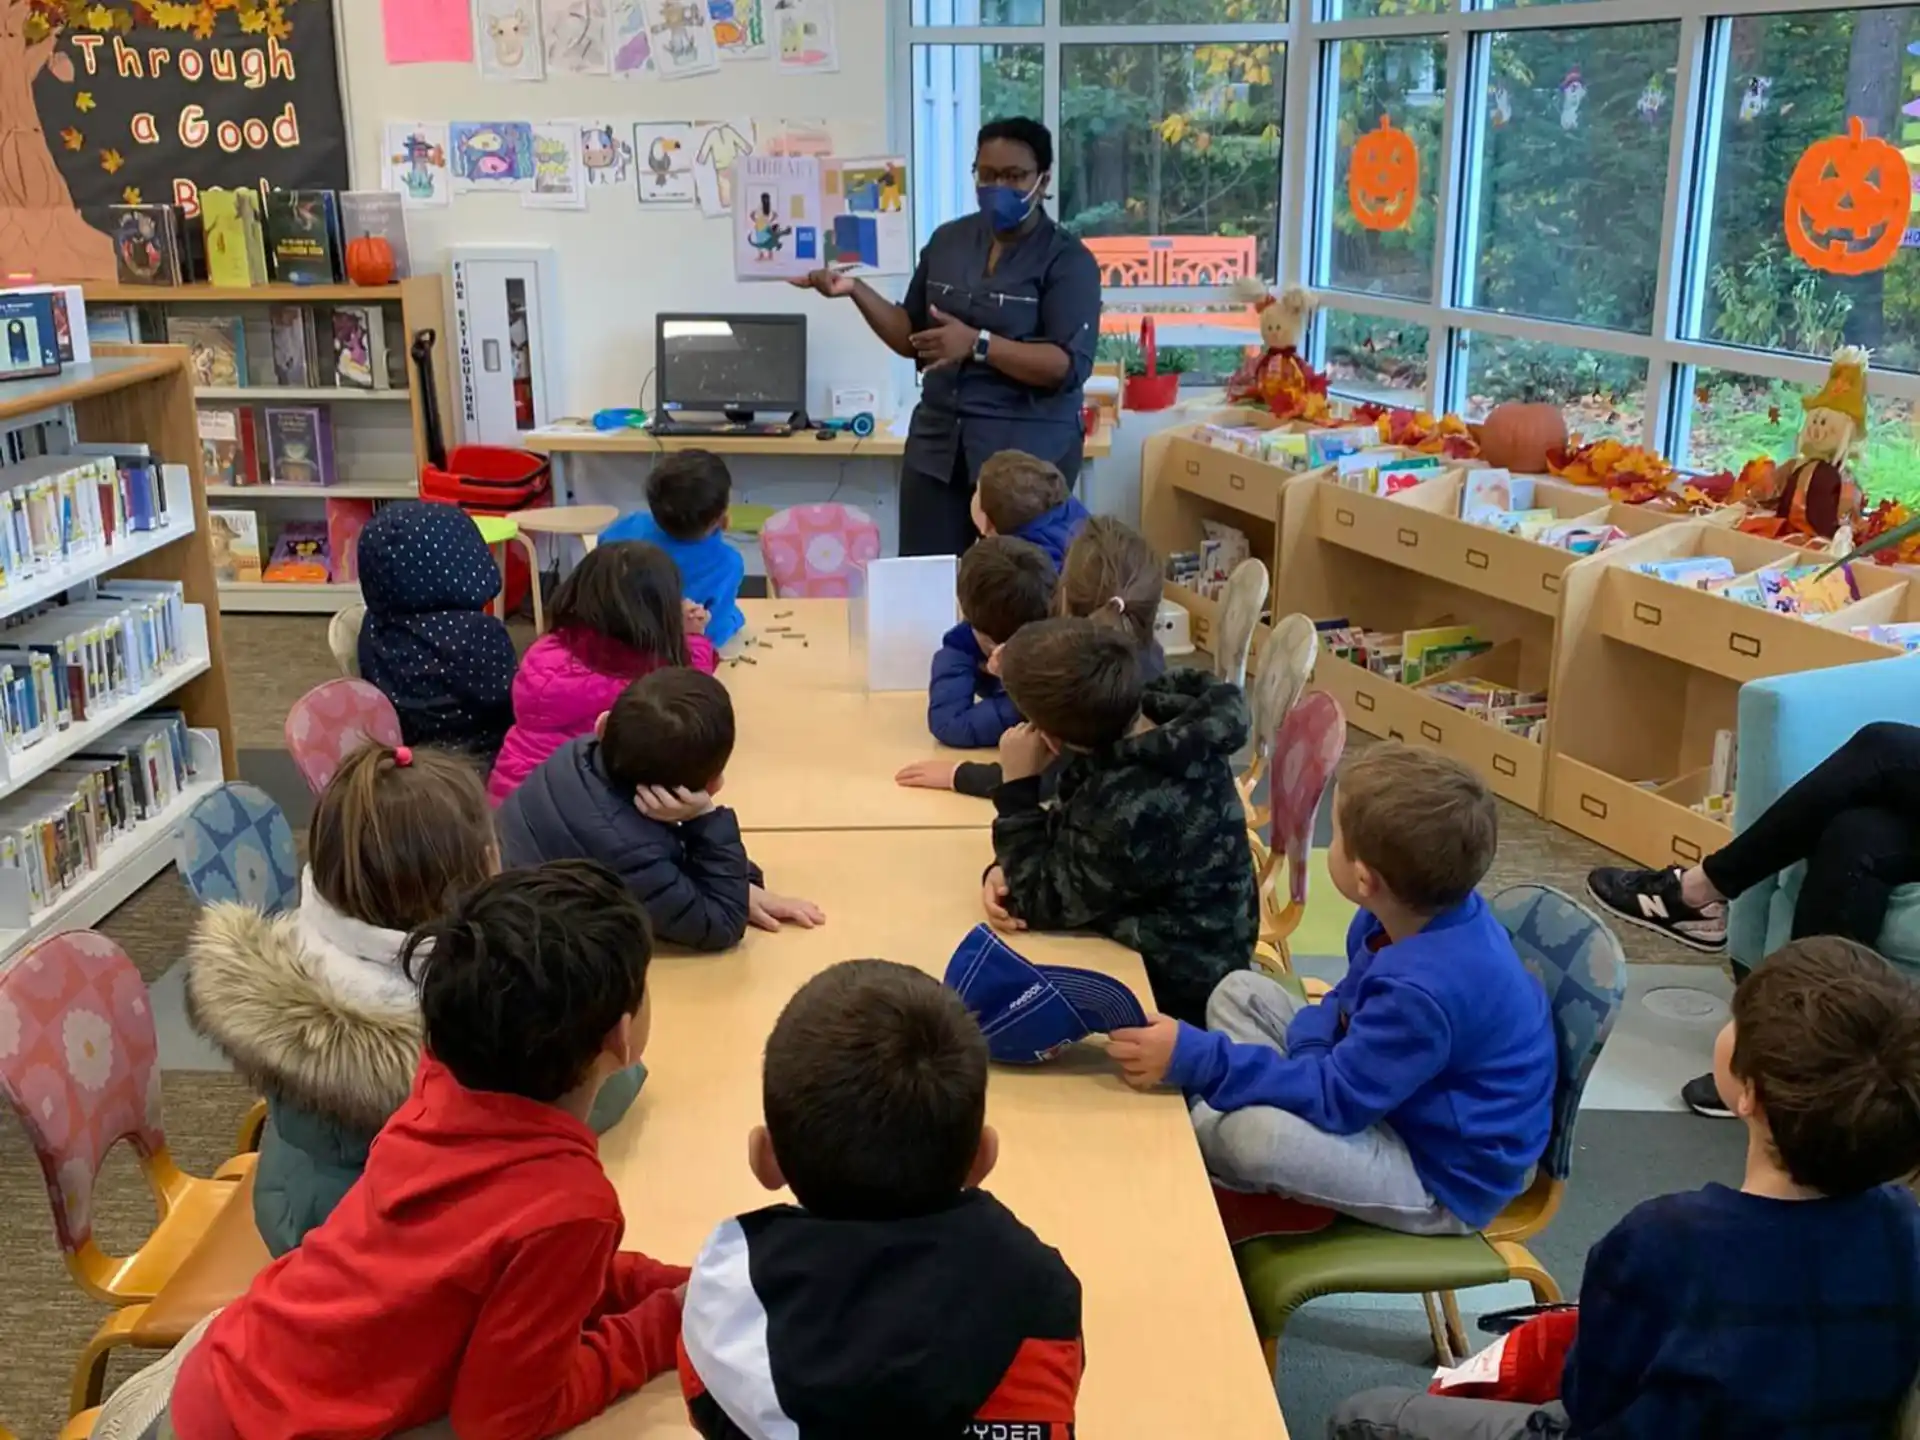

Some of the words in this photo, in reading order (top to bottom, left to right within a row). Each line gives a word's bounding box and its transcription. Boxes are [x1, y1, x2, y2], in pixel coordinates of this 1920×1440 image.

[71, 35, 296, 89] Through
[131, 113, 160, 144] a
[178, 102, 300, 152] Good
[454, 261, 464, 300] FIRE
[458, 310, 475, 421] EXTINGUISHER
